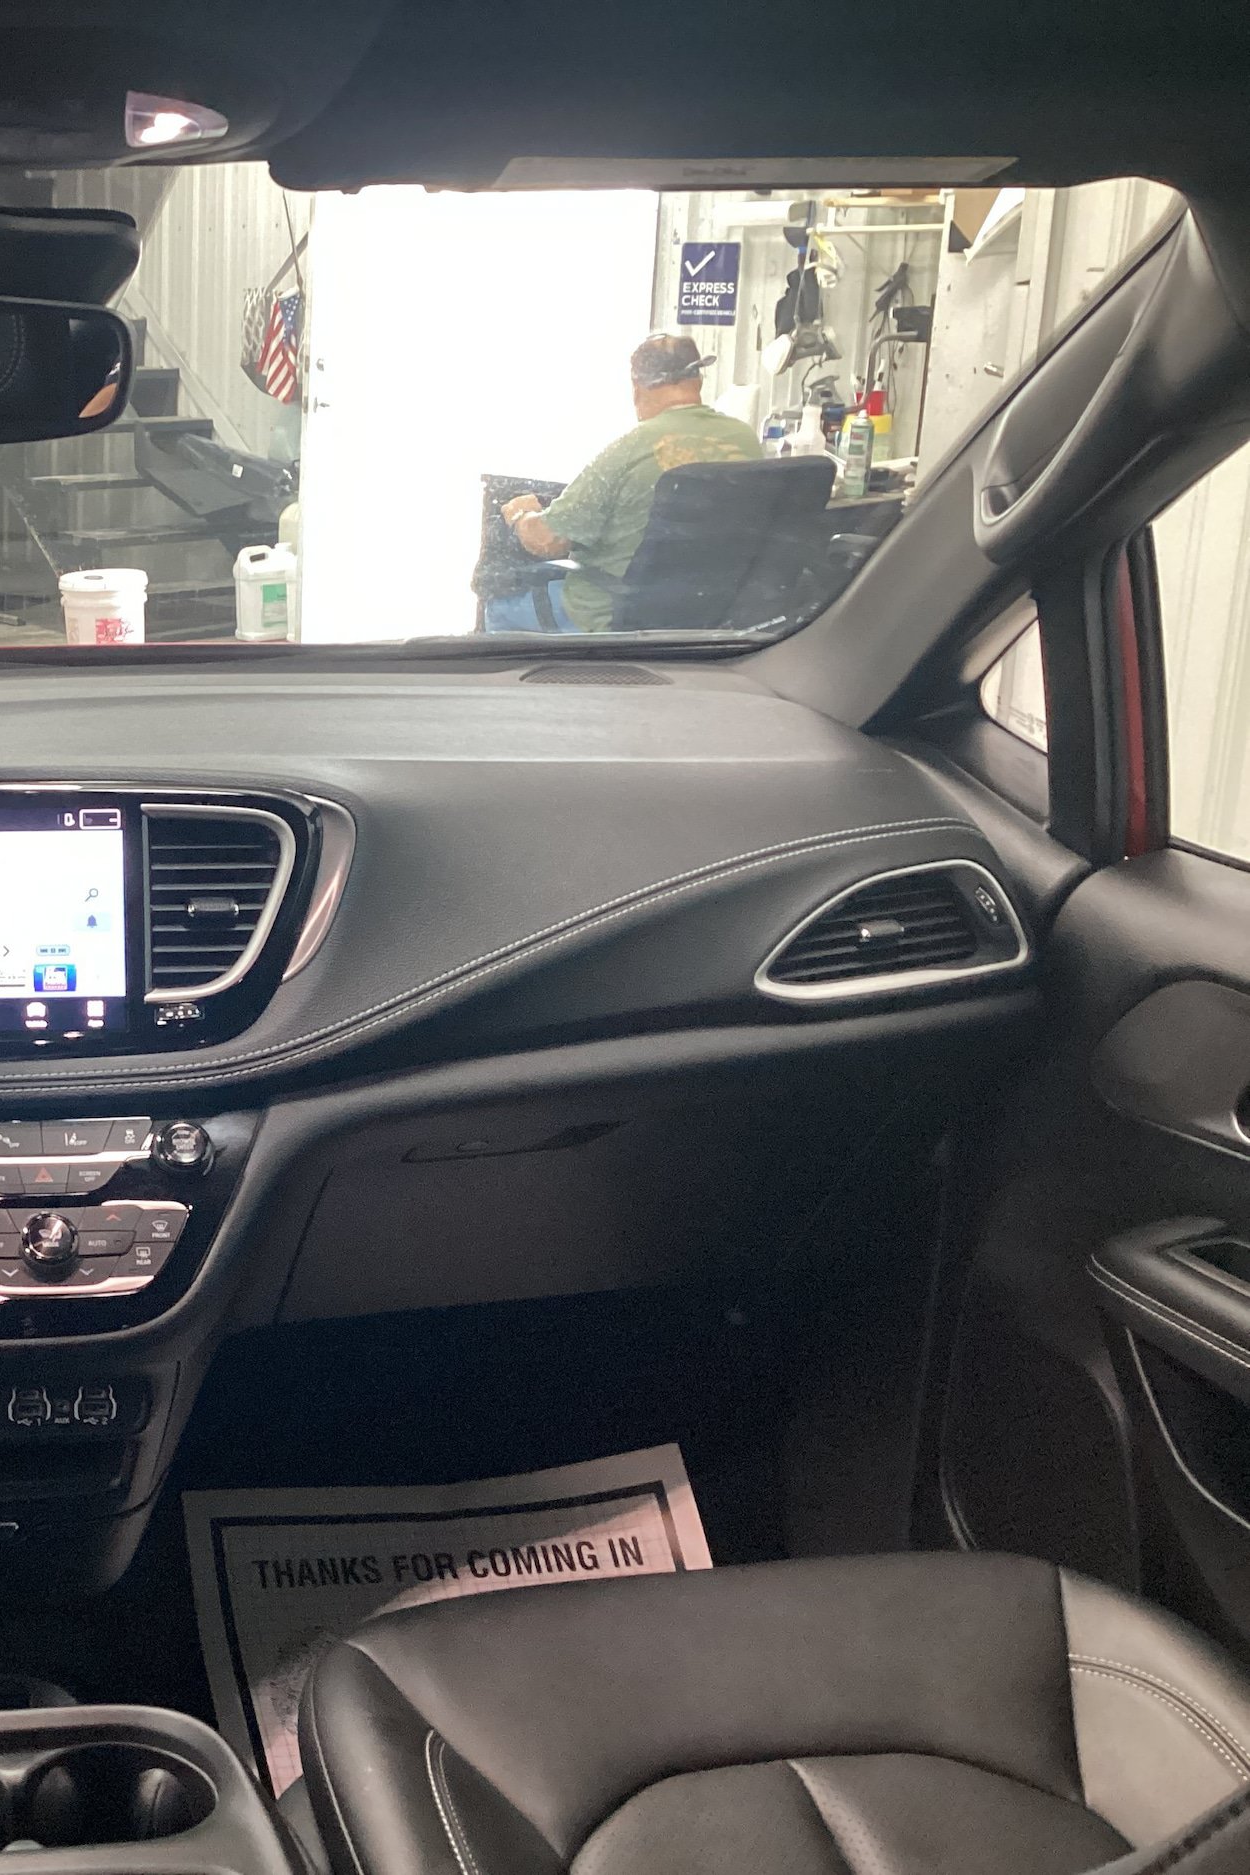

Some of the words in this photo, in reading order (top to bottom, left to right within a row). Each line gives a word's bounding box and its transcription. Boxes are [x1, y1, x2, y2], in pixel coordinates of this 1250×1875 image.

[682, 282, 735, 294] EXPRESS
[681, 294, 720, 307] CHECK
[252, 1555, 382, 1589] THANKS
[393, 1552, 459, 1583] FOR
[467, 1541, 598, 1578] COMING
[607, 1536, 644, 1568] IN
